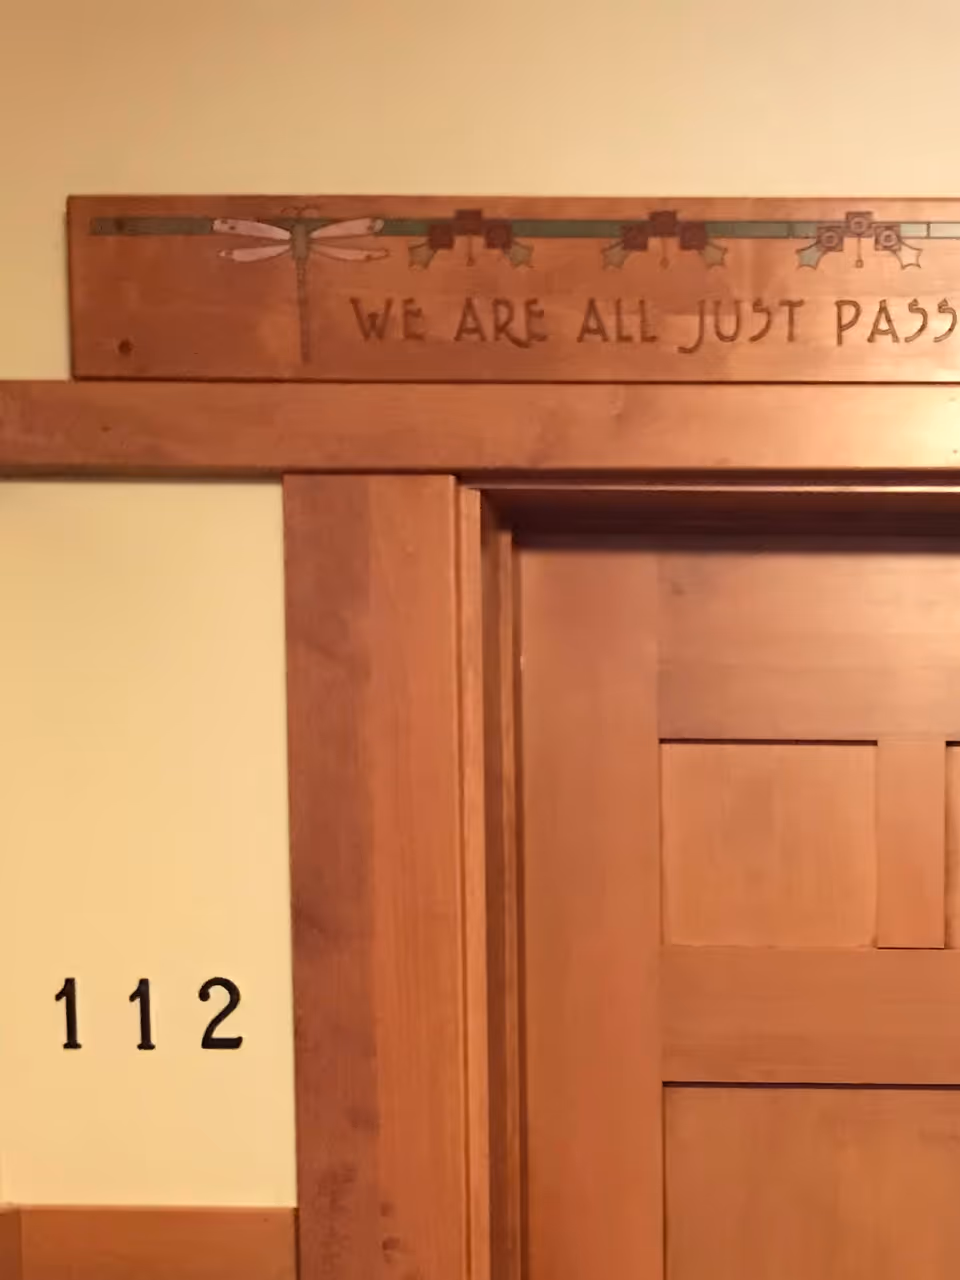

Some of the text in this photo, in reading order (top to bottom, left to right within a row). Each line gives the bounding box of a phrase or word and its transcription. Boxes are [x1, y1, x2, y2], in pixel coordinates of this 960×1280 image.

[350, 297, 425, 342] WE
[454, 297, 547, 348] ARE
[577, 297, 657, 343] ALL
[678, 299, 804, 354] JUST
[55, 976, 243, 1050] 112
